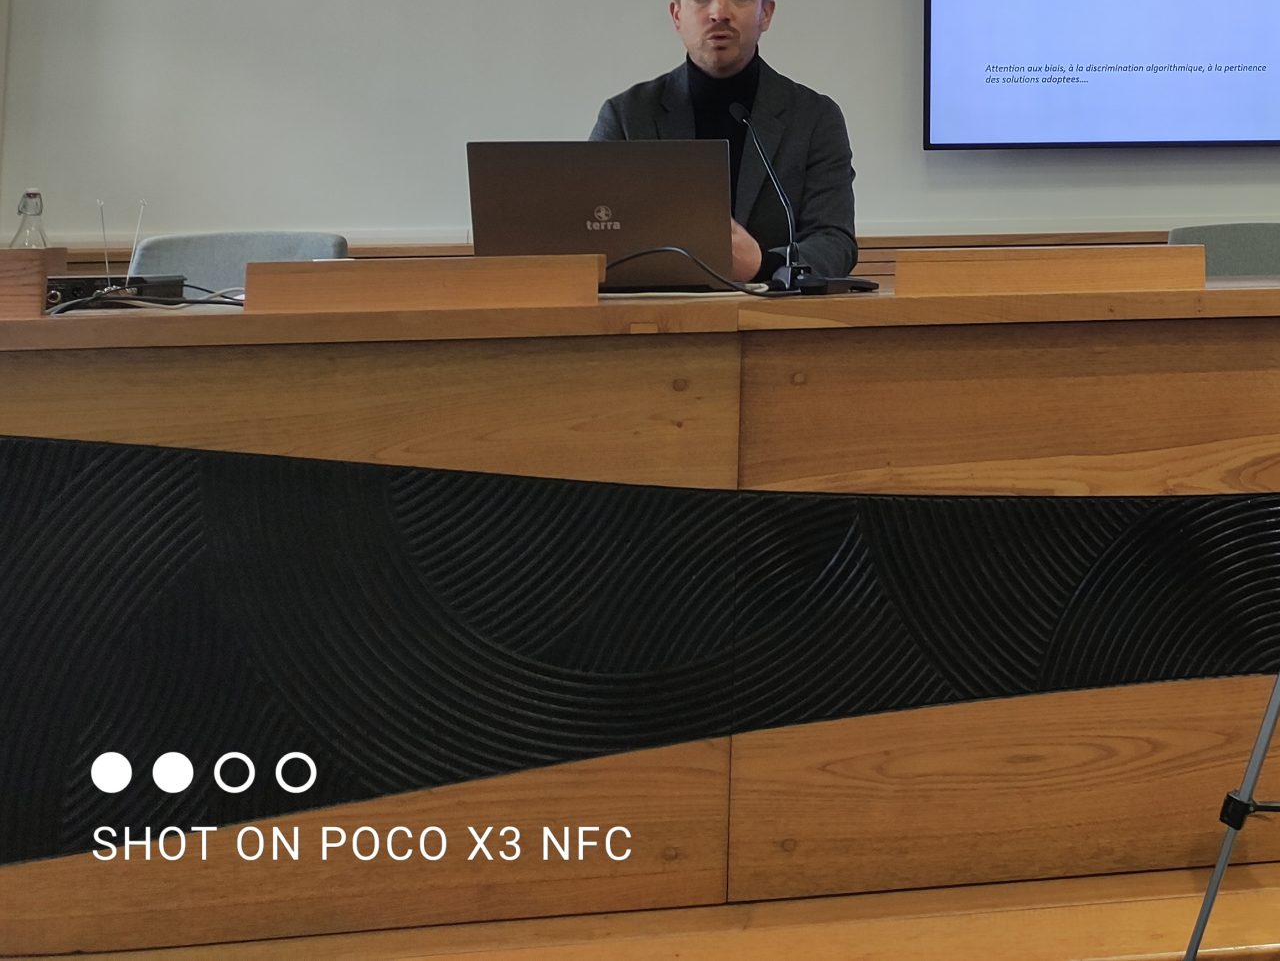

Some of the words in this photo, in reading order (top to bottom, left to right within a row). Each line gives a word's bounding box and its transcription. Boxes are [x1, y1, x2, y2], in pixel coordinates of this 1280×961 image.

[985, 64, 1025, 73] Attention
[1044, 64, 1066, 73] biais,
[1068, 64, 1074, 72] à
[1076, 64, 1084, 72] la
[1085, 63, 1144, 73] discrimination
[1146, 63, 1205, 73] algorithmique,
[1207, 63, 1213, 72] à
[1214, 63, 1222, 72] la
[1224, 63, 1267, 73] pertinence
[985, 75, 1000, 84] des
[1002, 75, 1039, 84] solutions
[586, 220, 621, 230] terra
